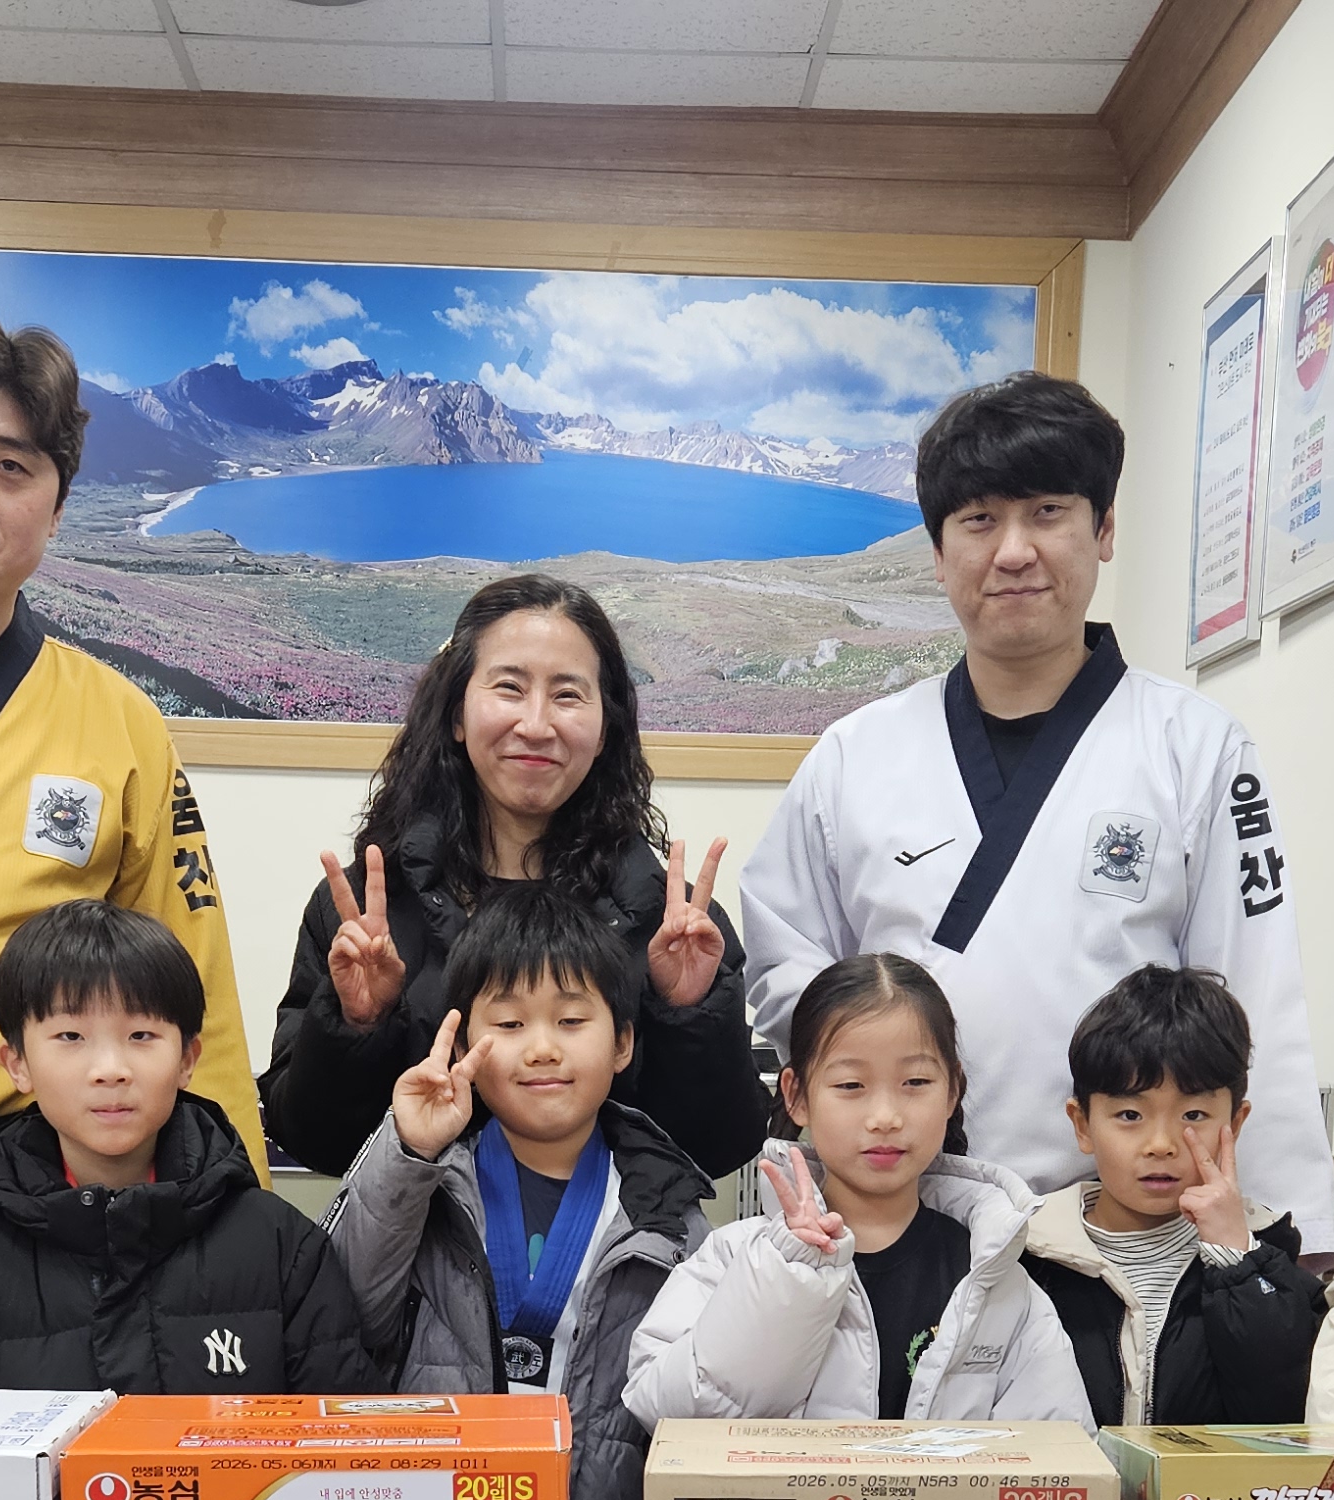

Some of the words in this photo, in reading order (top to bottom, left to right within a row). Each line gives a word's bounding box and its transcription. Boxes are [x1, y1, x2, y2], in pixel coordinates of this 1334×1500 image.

[1229, 772, 1286, 919] 움찬
[202, 1328, 250, 1377] NY
[389, 1458, 441, 1470] 08:29
[358, 1486, 403, 1500] 안성맞춤
[514, 1475, 535, 1500] S
